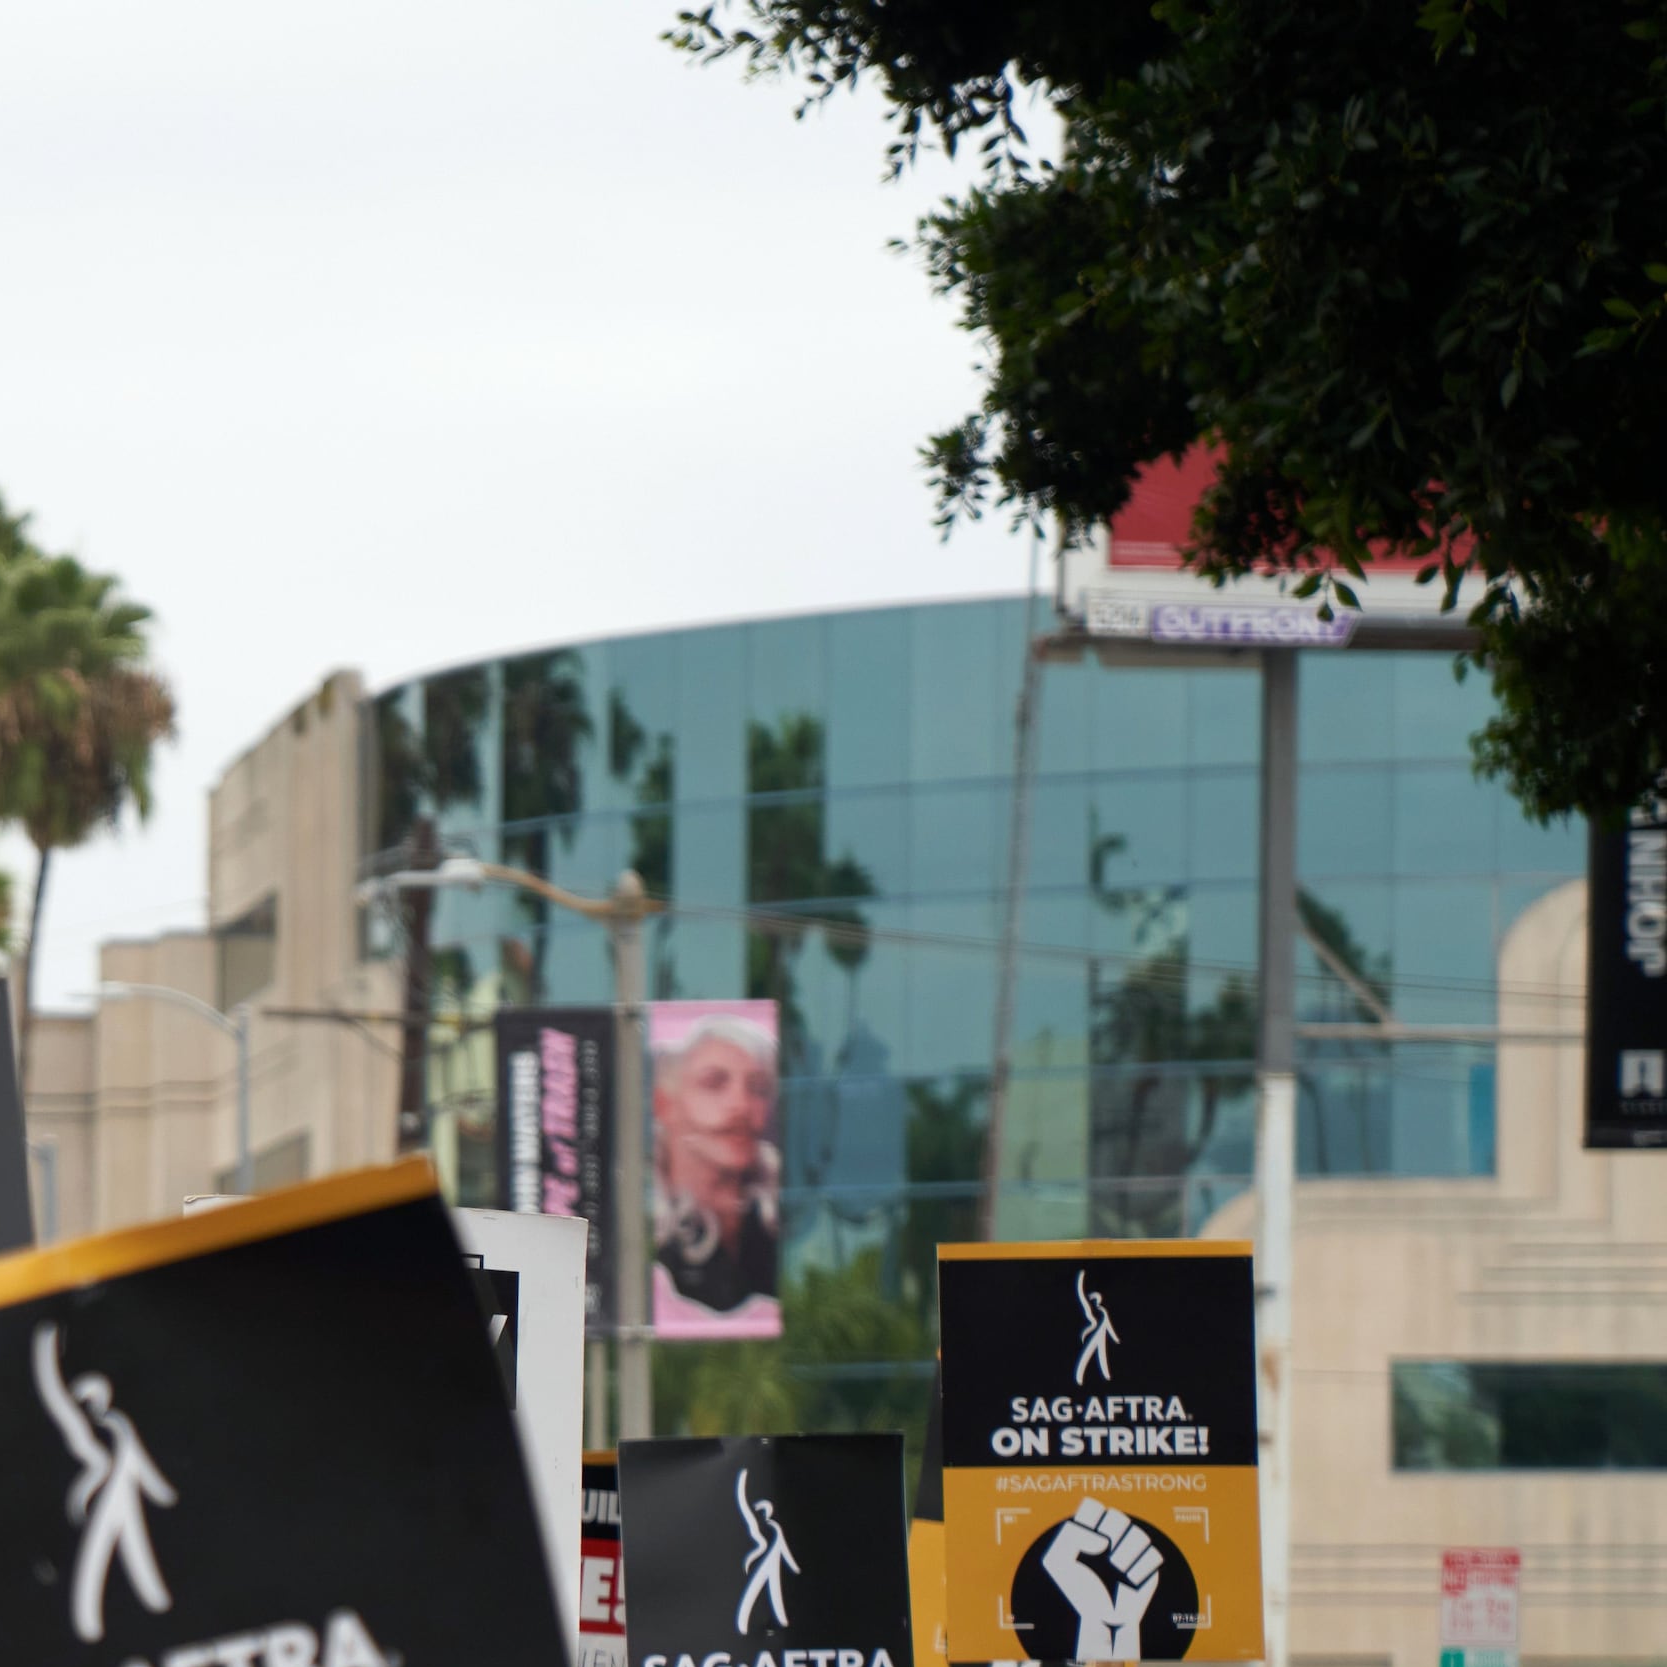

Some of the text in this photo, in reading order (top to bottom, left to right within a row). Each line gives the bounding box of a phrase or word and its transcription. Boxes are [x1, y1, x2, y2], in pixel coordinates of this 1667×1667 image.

[991, 1425, 1210, 1457] ON STRIKE!
[996, 1472, 1208, 1494] #SAGAFTRASTRONG
